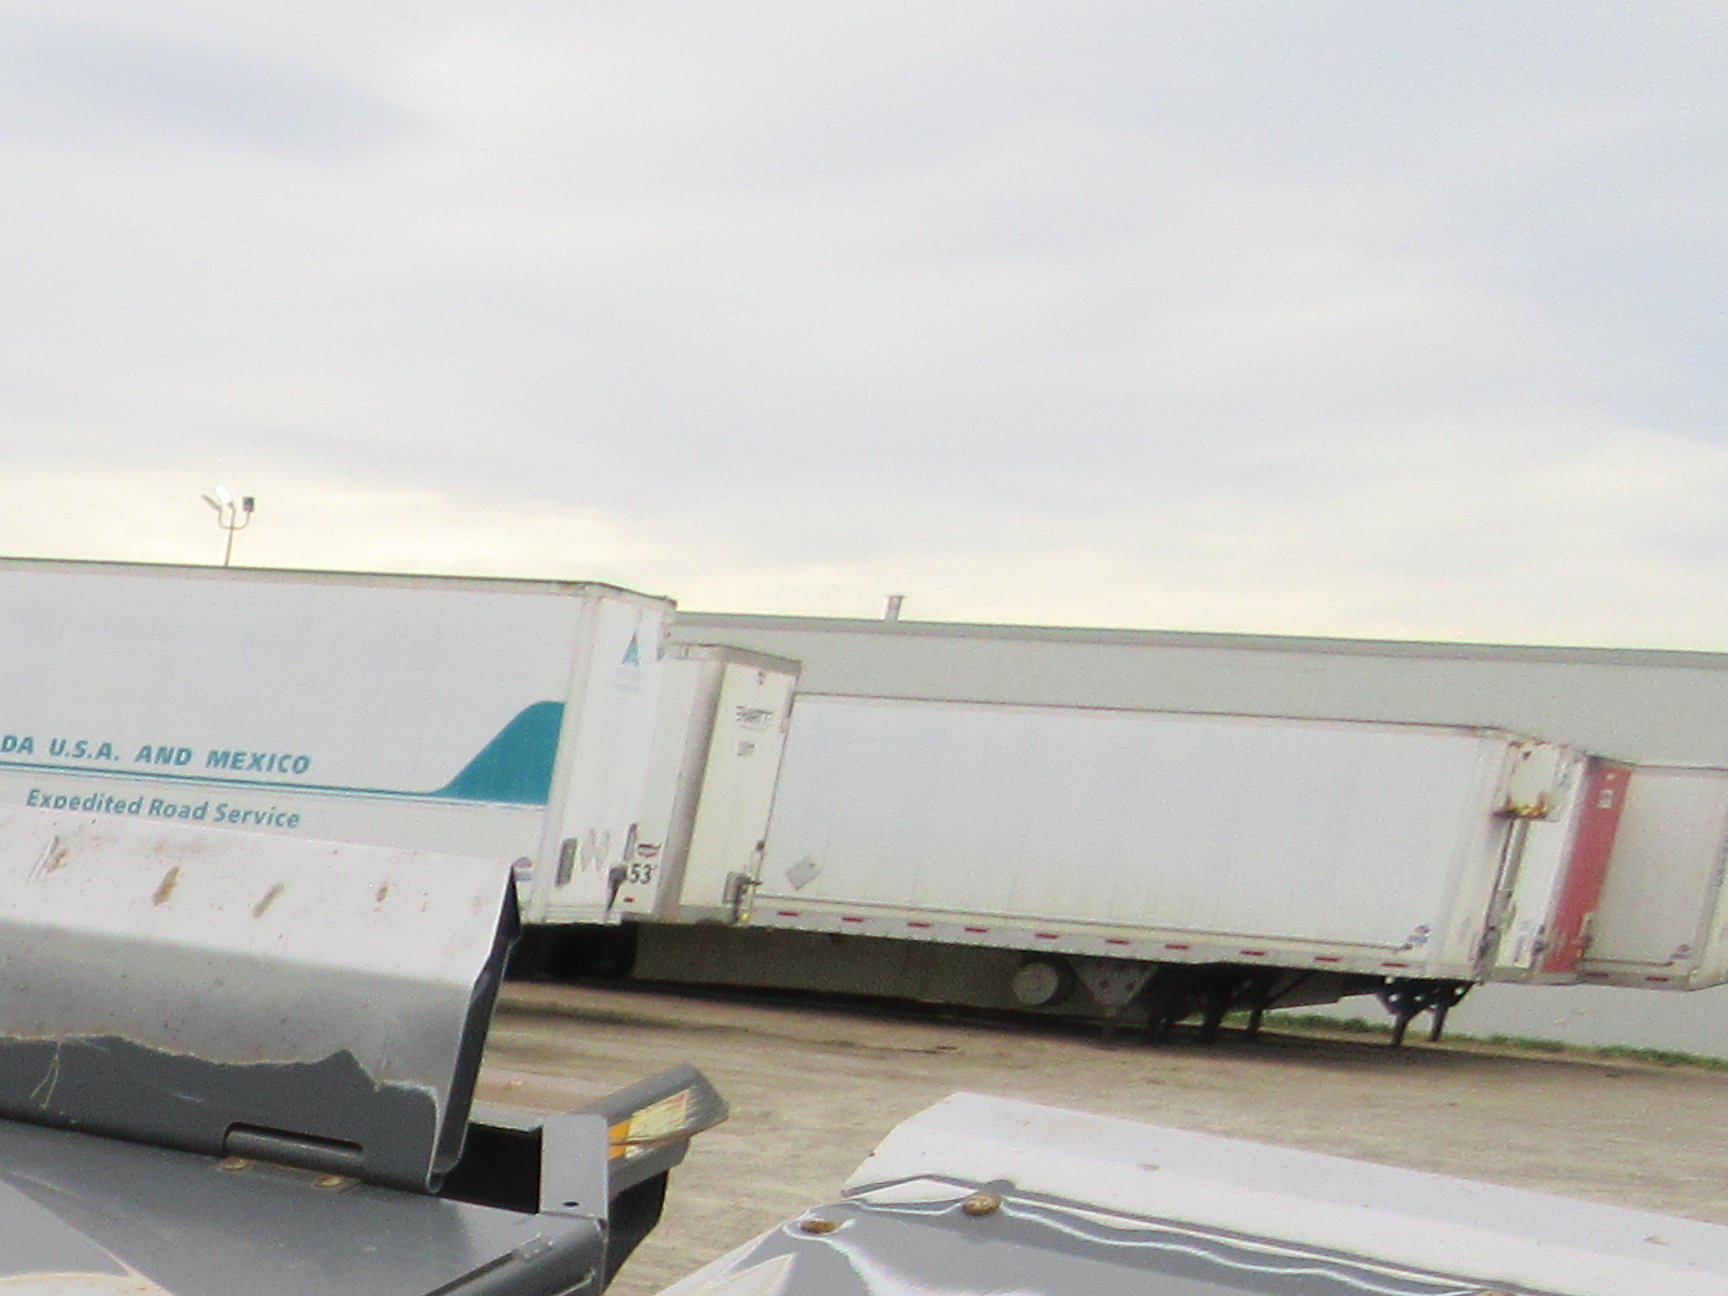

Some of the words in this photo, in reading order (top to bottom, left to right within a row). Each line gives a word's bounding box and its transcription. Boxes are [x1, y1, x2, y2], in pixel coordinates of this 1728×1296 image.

[49, 737, 120, 763] U.S.A.
[134, 744, 193, 767] AND
[206, 749, 312, 775] MEXICO
[25, 788, 145, 818] Expedited
[148, 799, 209, 822] Road
[215, 803, 300, 829] Service
